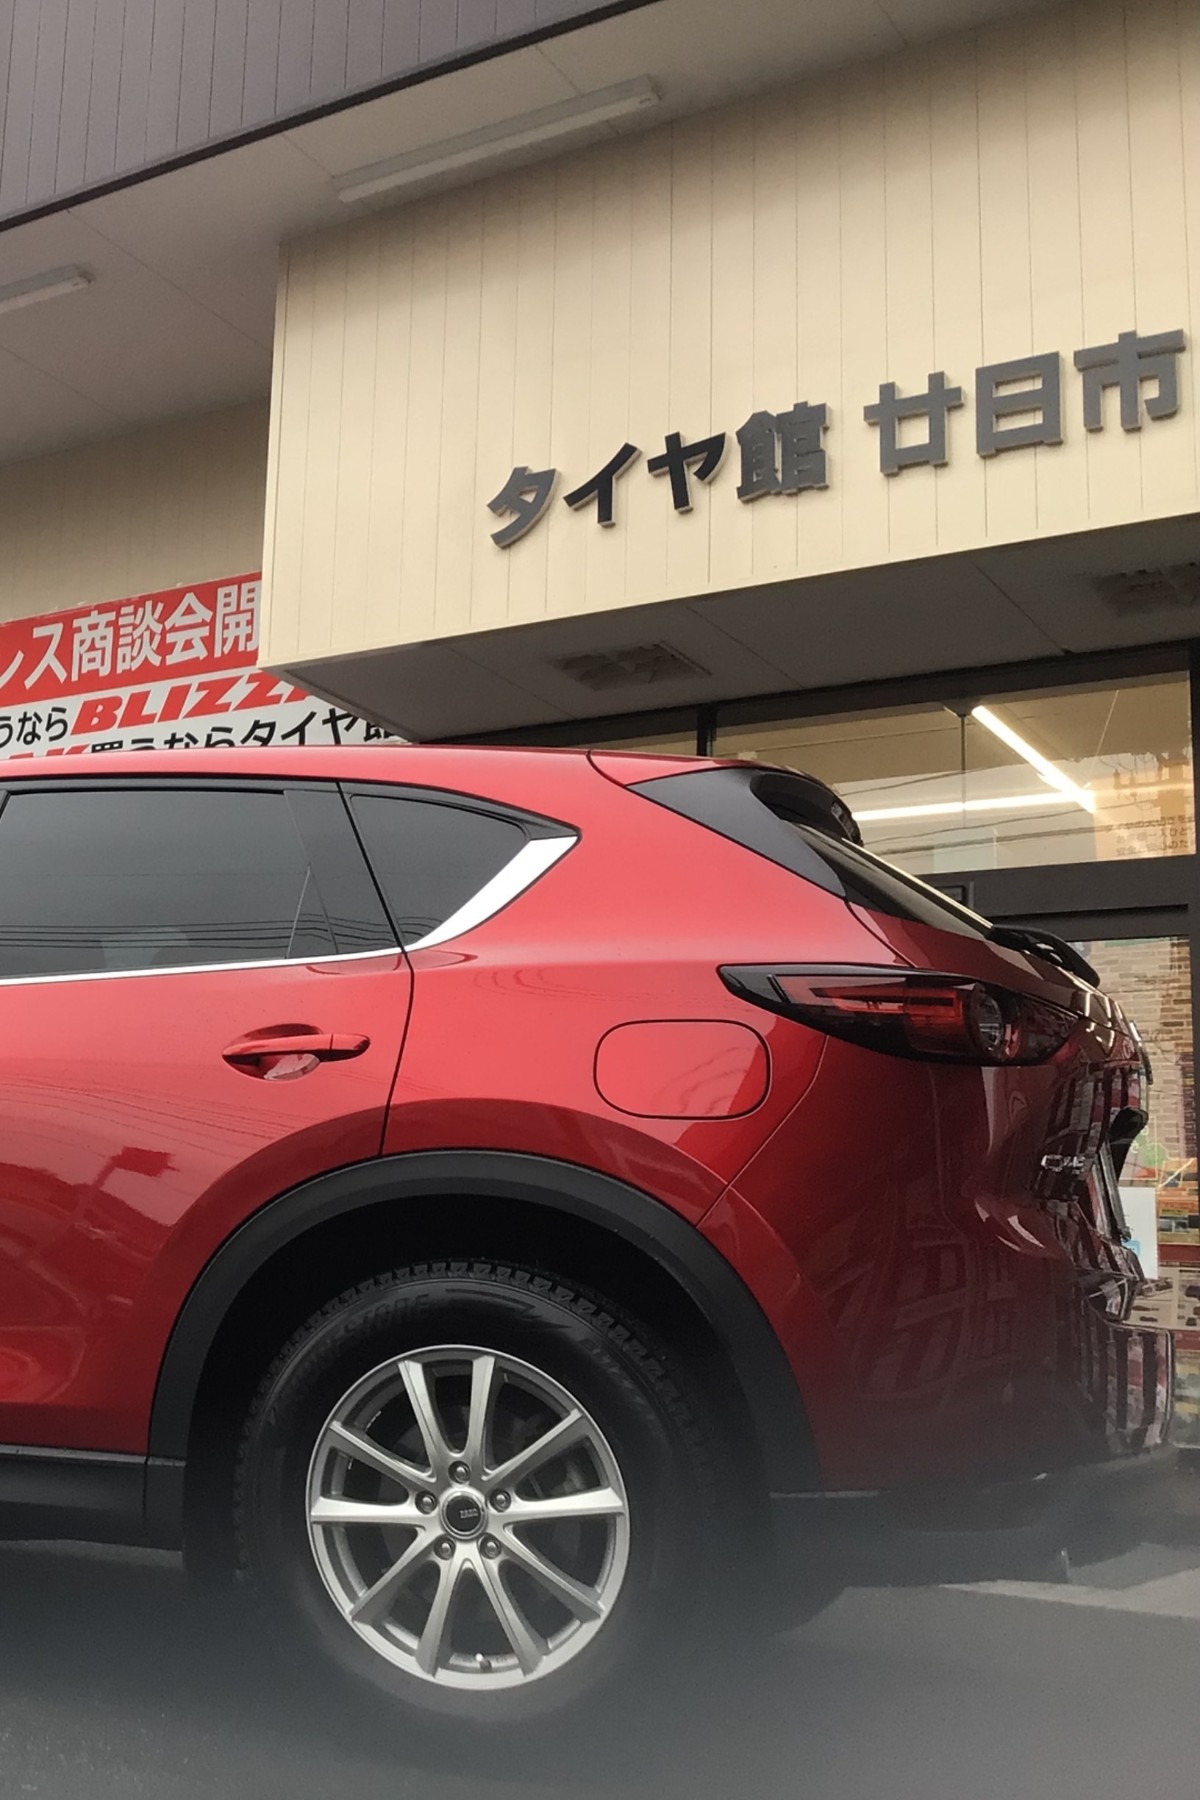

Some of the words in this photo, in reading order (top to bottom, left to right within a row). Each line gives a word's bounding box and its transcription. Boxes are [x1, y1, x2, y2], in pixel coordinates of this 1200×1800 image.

[486, 401, 832, 549] タイヤ館
[863, 329, 1187, 476] 廿日市
